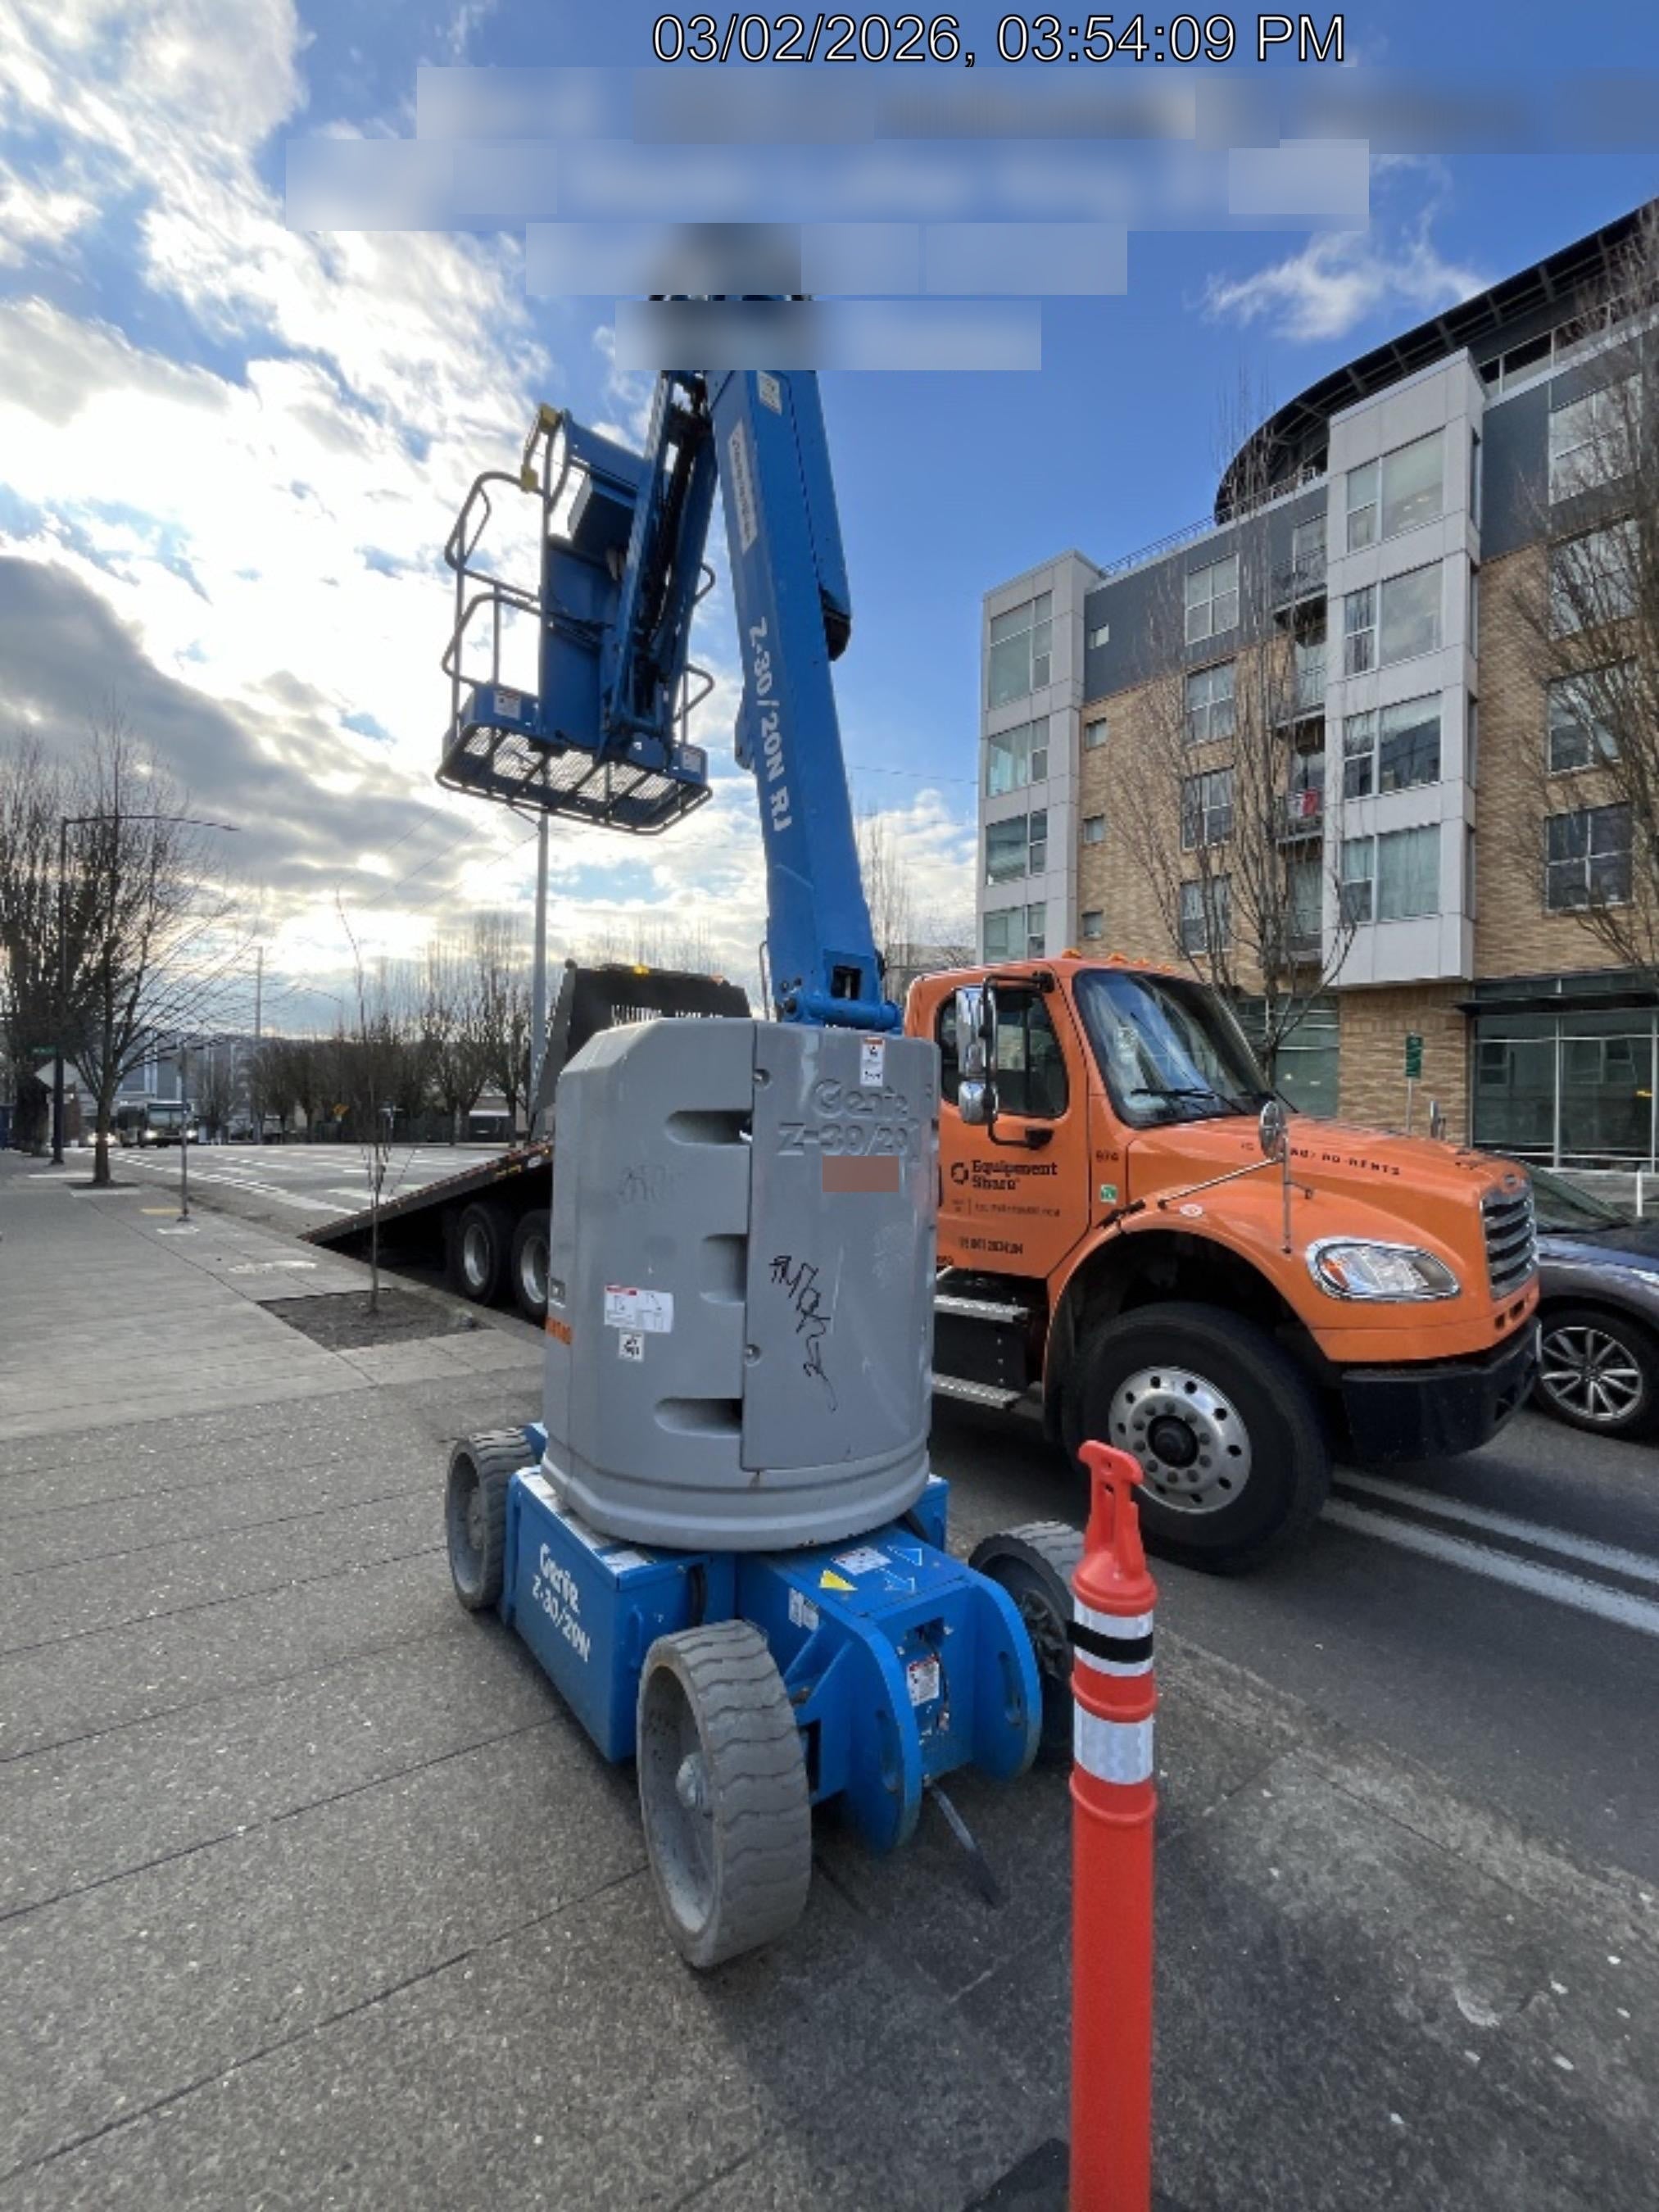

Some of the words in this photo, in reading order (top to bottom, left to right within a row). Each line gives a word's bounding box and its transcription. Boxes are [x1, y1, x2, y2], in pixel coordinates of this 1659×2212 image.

[749, 616, 784, 782] Z-30/20N
[972, 1159, 1058, 1177] Equipment
[972, 1176, 1017, 1190] Share
[540, 1543, 580, 1615] Genie
[533, 1574, 591, 1663] Z-30/20N
